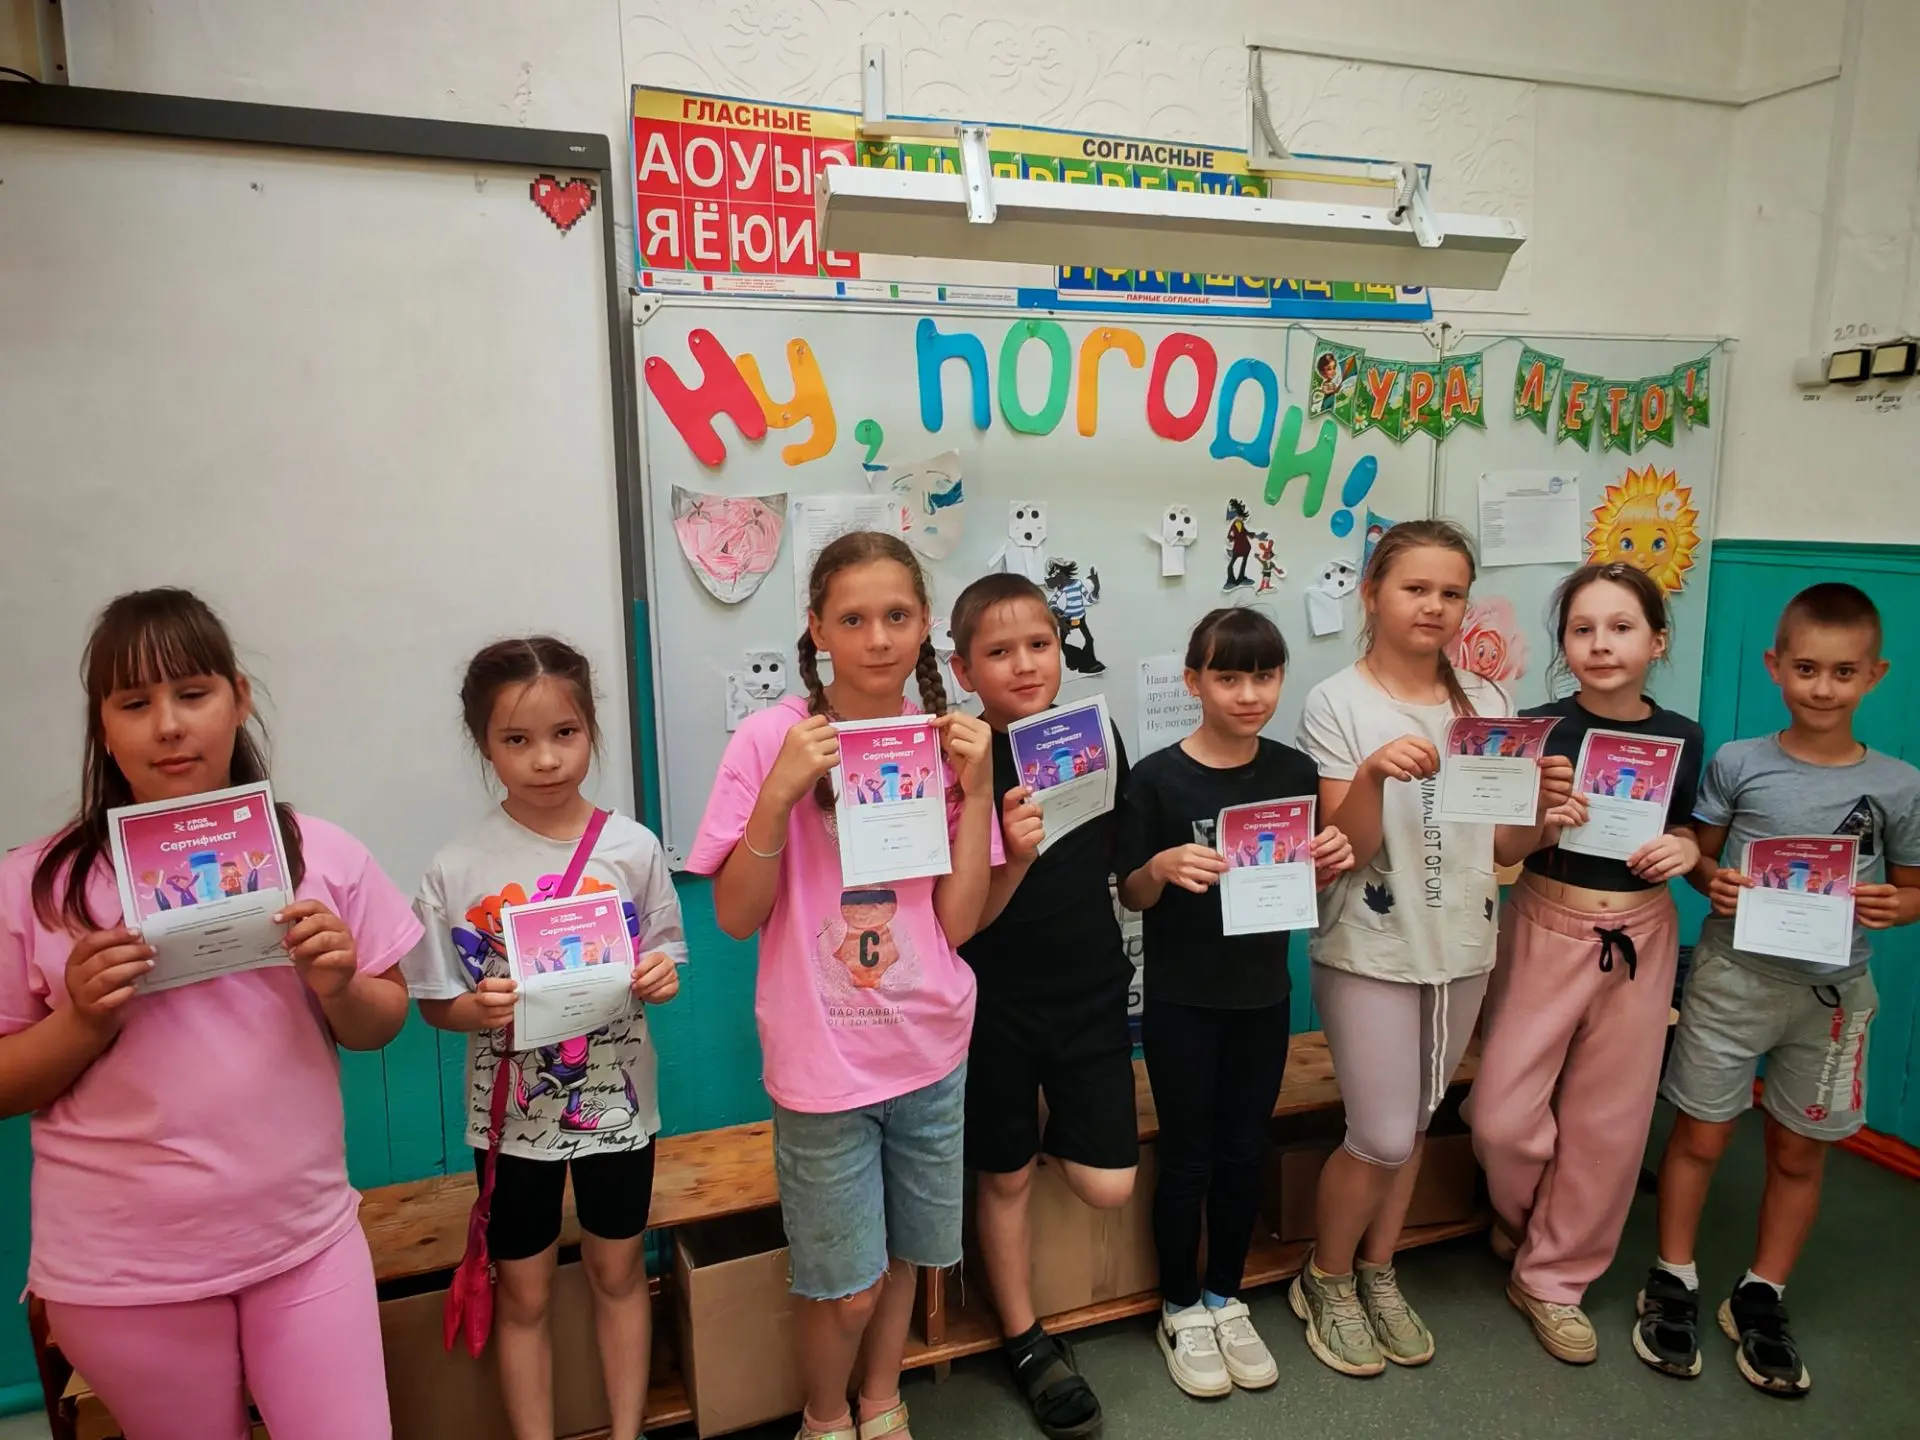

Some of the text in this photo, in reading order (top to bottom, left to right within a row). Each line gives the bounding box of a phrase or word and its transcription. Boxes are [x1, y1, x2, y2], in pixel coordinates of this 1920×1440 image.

[682, 98, 811, 132] ГЛАСНЫЕ
[1082, 138, 1214, 169] СОГЛАСНЫЕ
[1126, 294, 1210, 304] ПАРНЫЕ СОГЛАСНЫЕ
[1520, 361, 1696, 436] ЛЕТО!
[1163, 705, 1181, 715] ему
[1420, 776, 1442, 851] NIMALIST
[160, 831, 237, 852] Сертификат
[859, 930, 880, 968] C
[829, 1006, 902, 1017] BAD RABBIT
